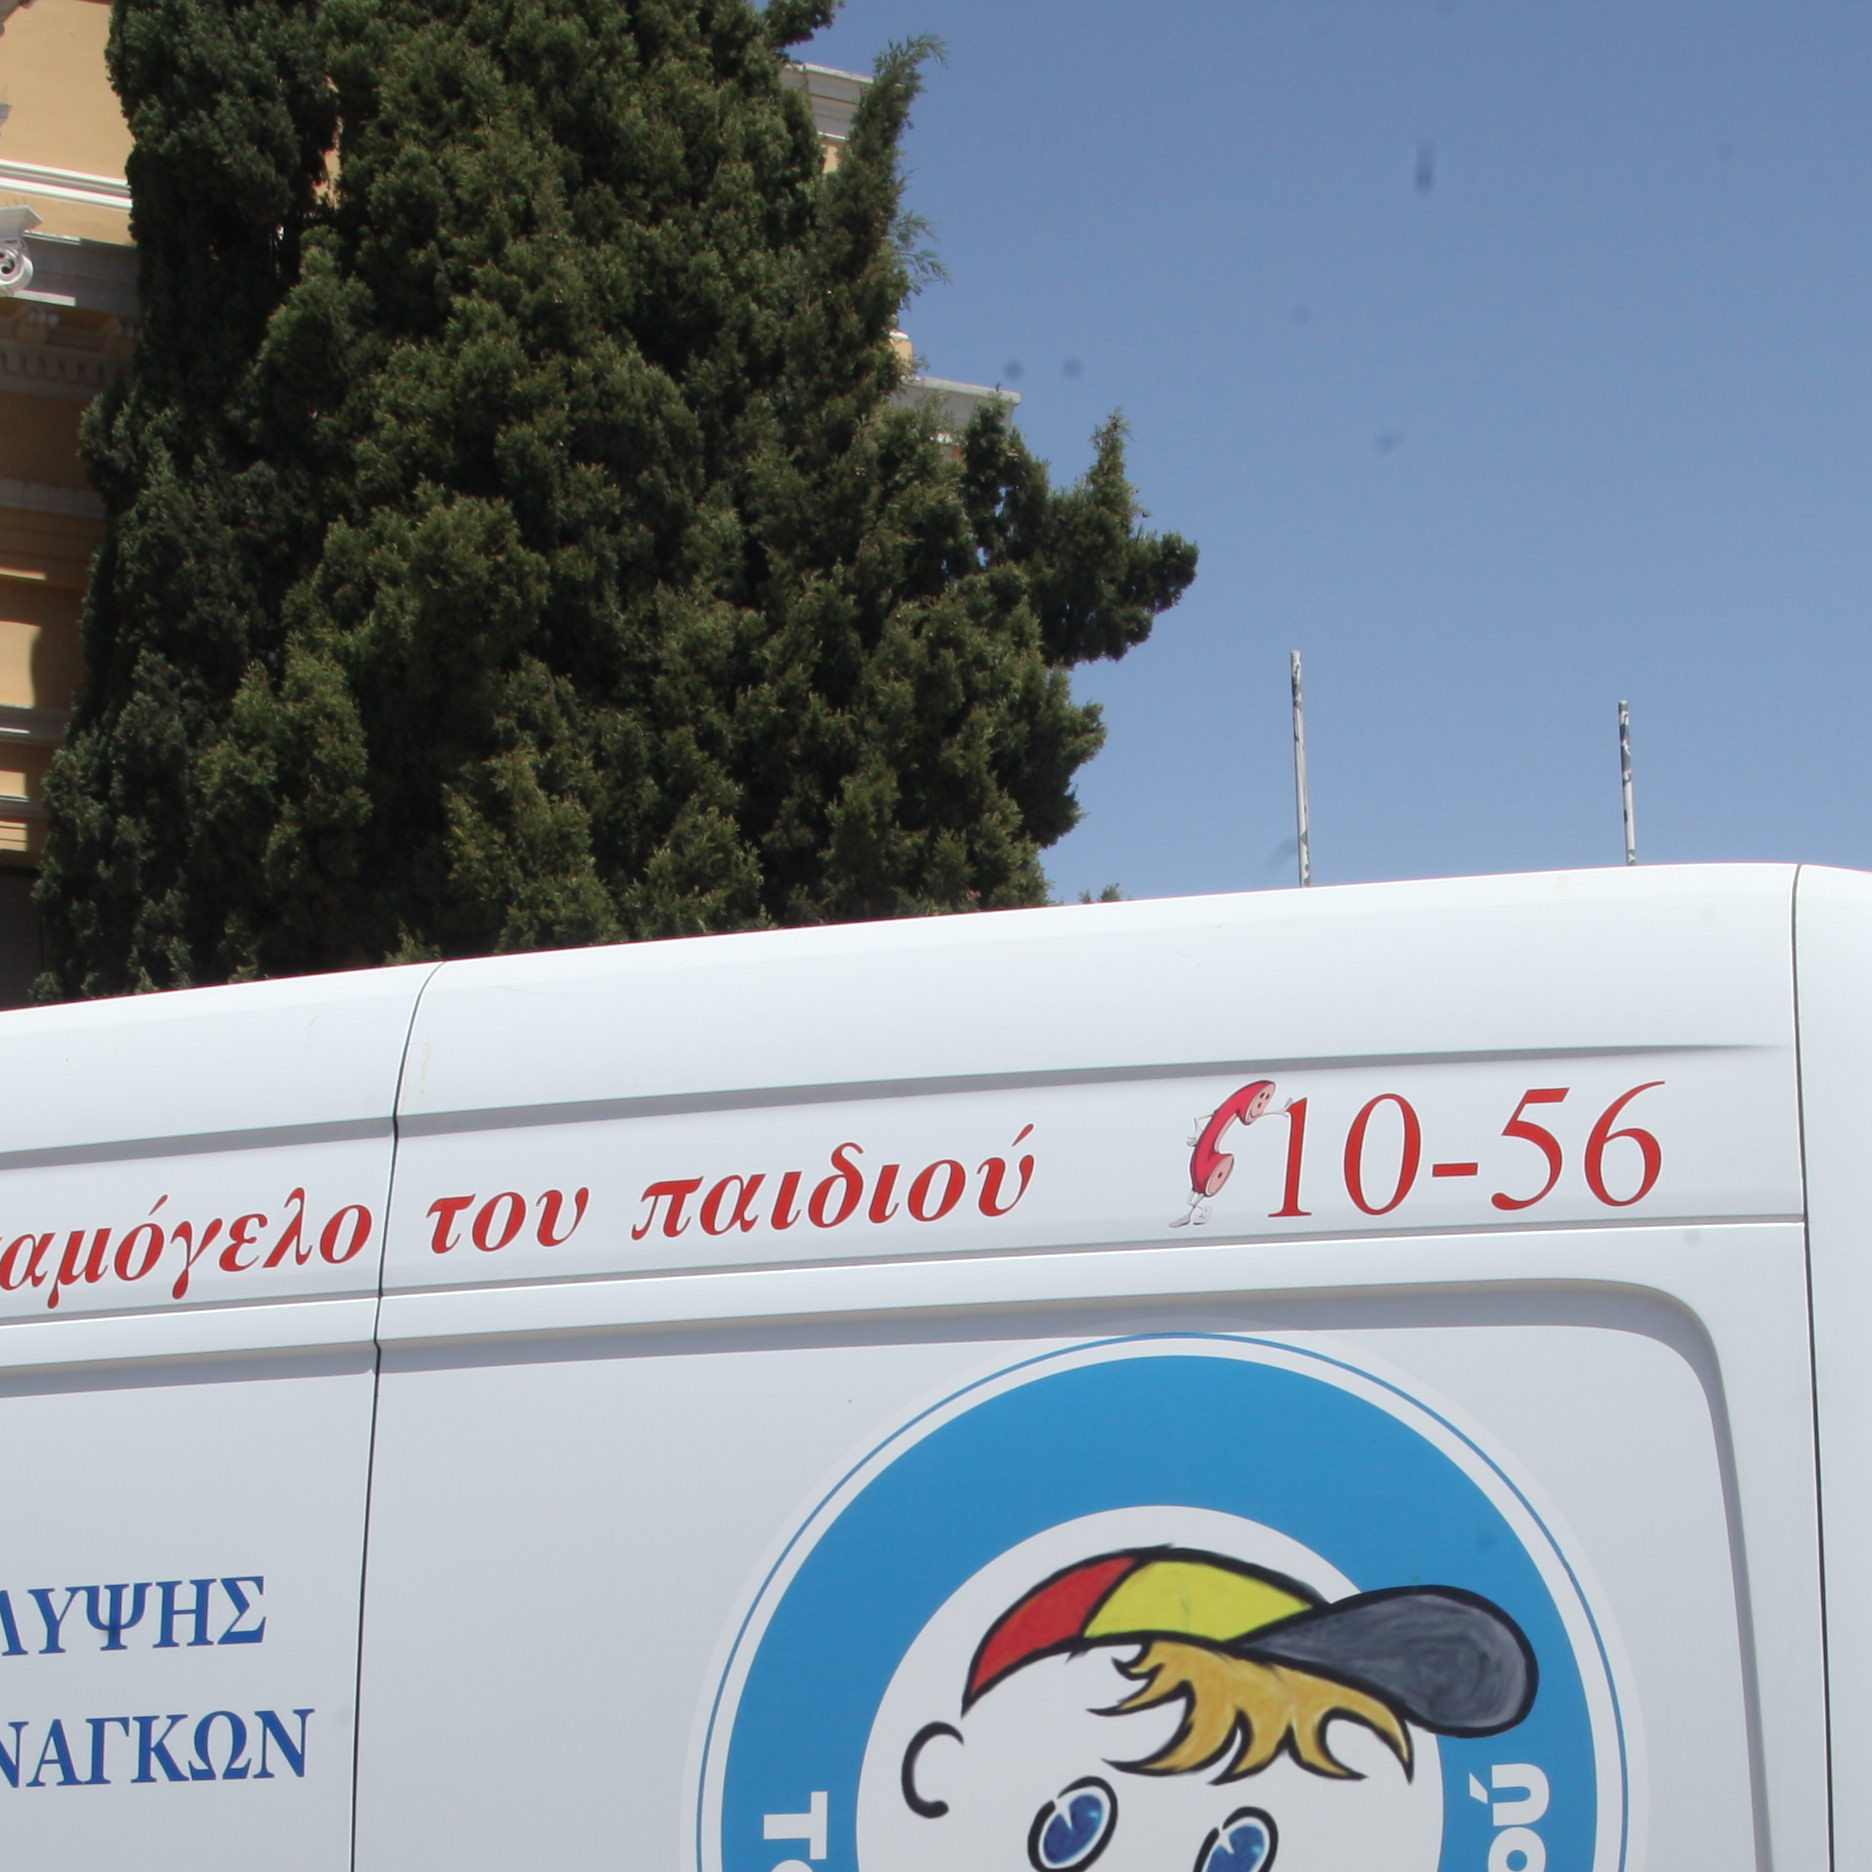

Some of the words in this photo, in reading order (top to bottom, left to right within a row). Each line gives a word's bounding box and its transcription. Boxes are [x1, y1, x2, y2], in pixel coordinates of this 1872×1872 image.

[426, 1186, 590, 1255] του
[631, 1122, 1035, 1241] παιδιού
[1268, 1080, 1666, 1218] 10-56
